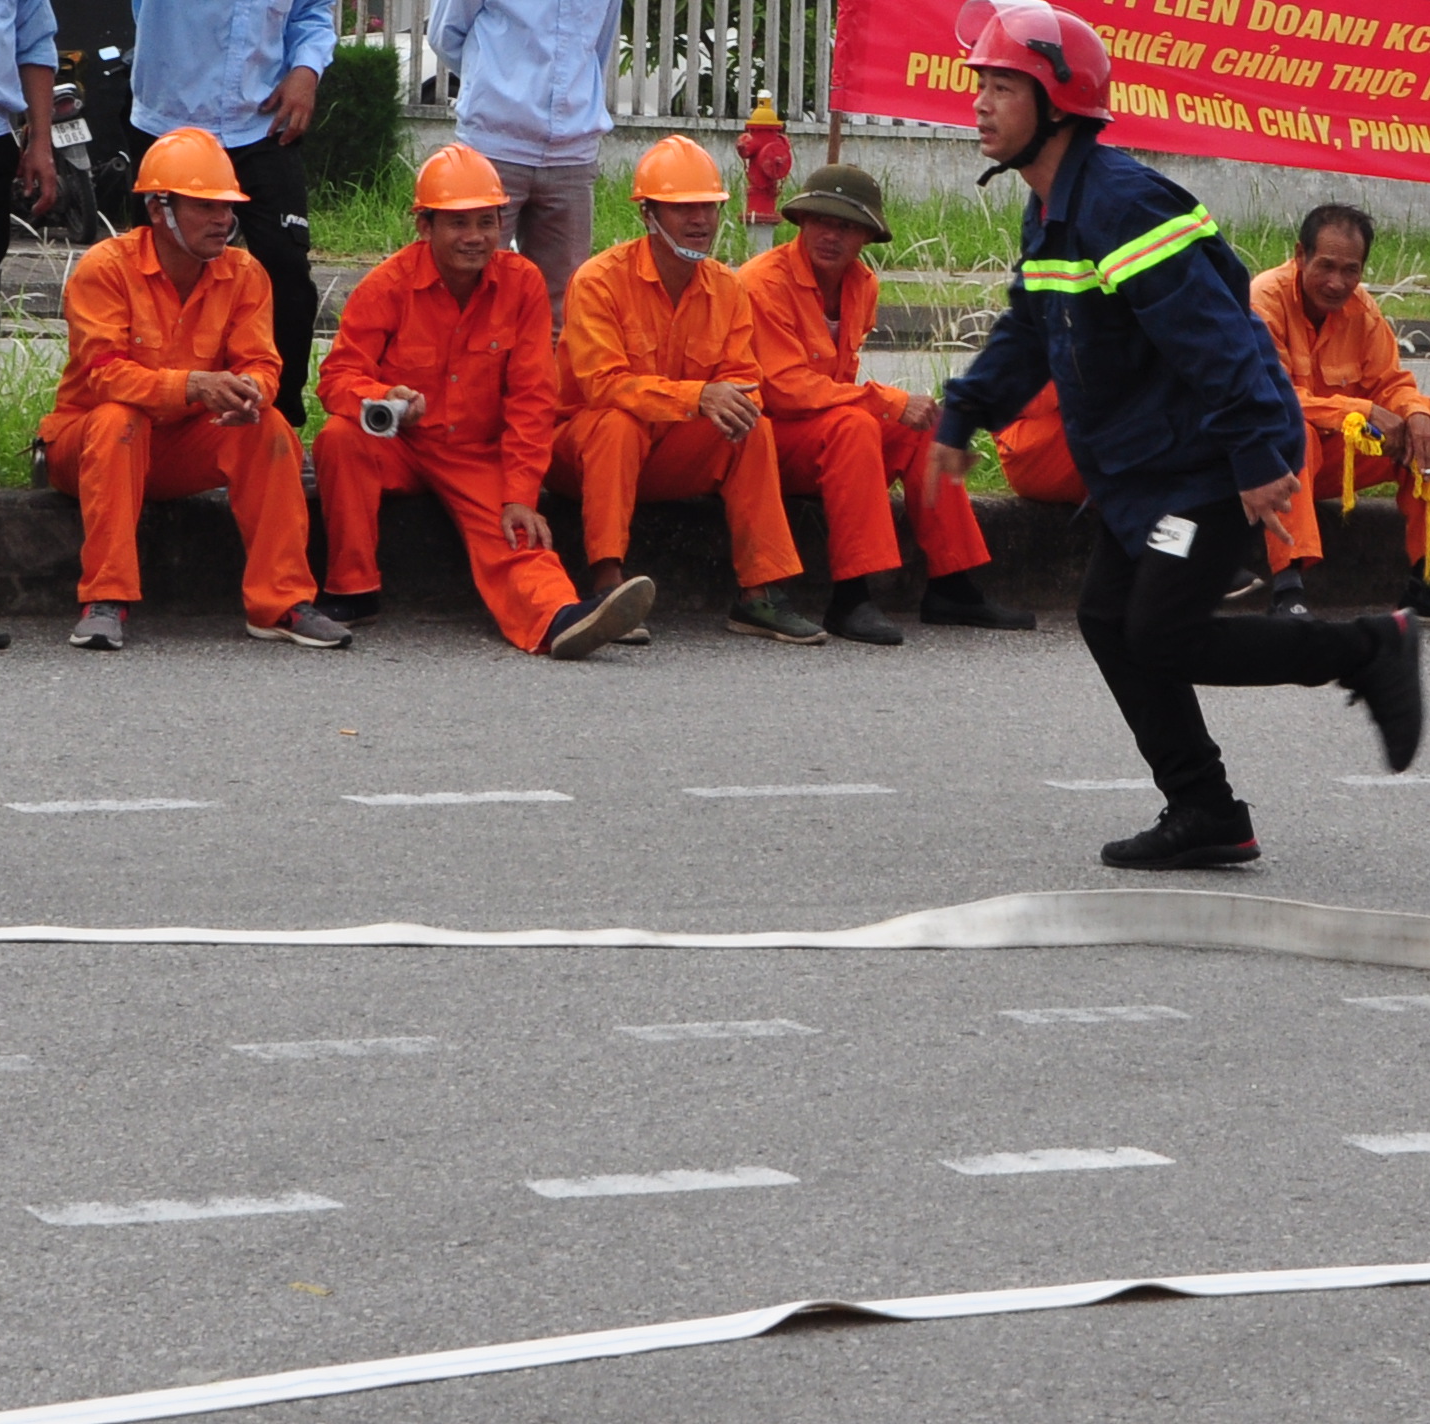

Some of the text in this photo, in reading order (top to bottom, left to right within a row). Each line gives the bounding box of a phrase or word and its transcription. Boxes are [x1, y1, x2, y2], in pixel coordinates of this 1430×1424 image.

[906, 49, 979, 95] PHÒ
[1109, 79, 1170, 120] HƠN
[1175, 92, 1255, 133] CHỮA
[1257, 106, 1343, 151] CHÁY,
[1090, 21, 1207, 70] GHIÊM
[1211, 44, 1324, 89] CHỈNH
[1328, 63, 1418, 101] THỰC
